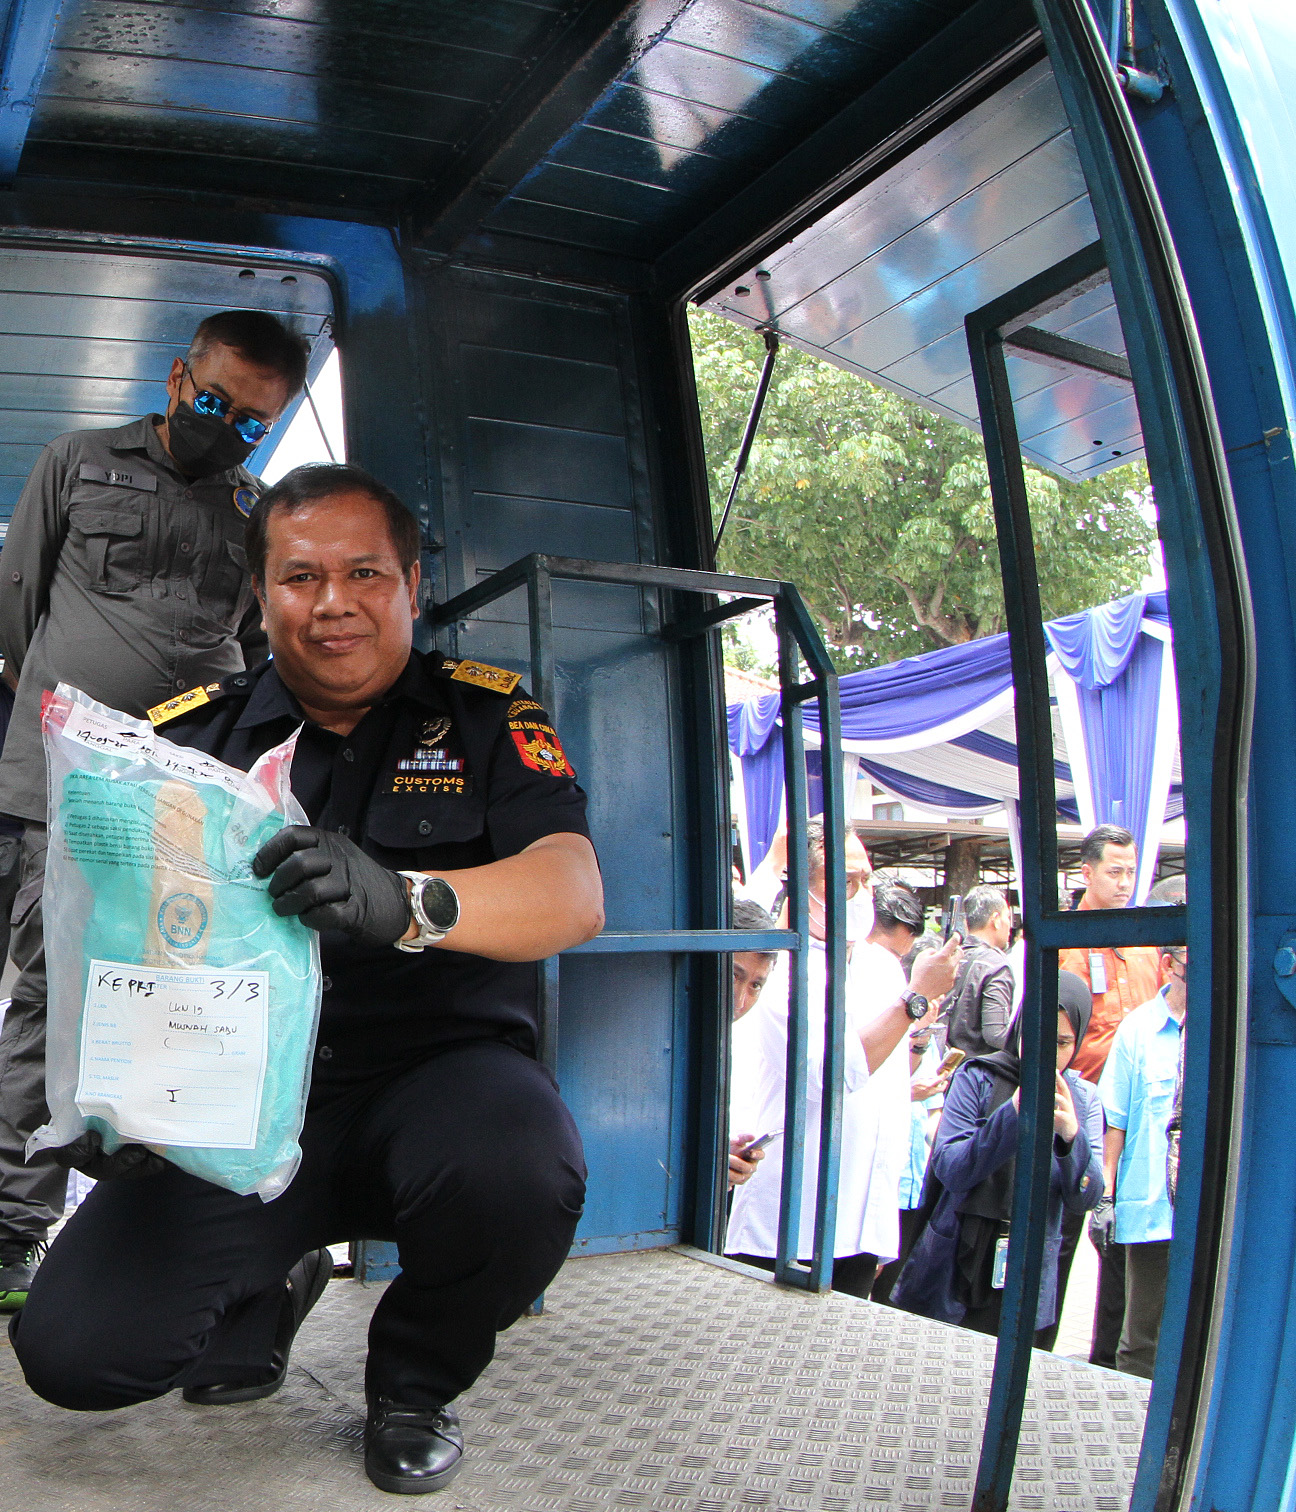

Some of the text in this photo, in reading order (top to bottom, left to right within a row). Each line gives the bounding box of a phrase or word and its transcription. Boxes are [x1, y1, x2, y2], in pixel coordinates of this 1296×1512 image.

[508, 721, 524, 730] BEA
[524, 721, 539, 730] DAN
[394, 776, 464, 786] CUSTOMS
[392, 785, 463, 793] EXCISE
[170, 924, 192, 937] BNN
[155, 974, 184, 983] BARANG
[210, 979, 260, 1002] 3/3
